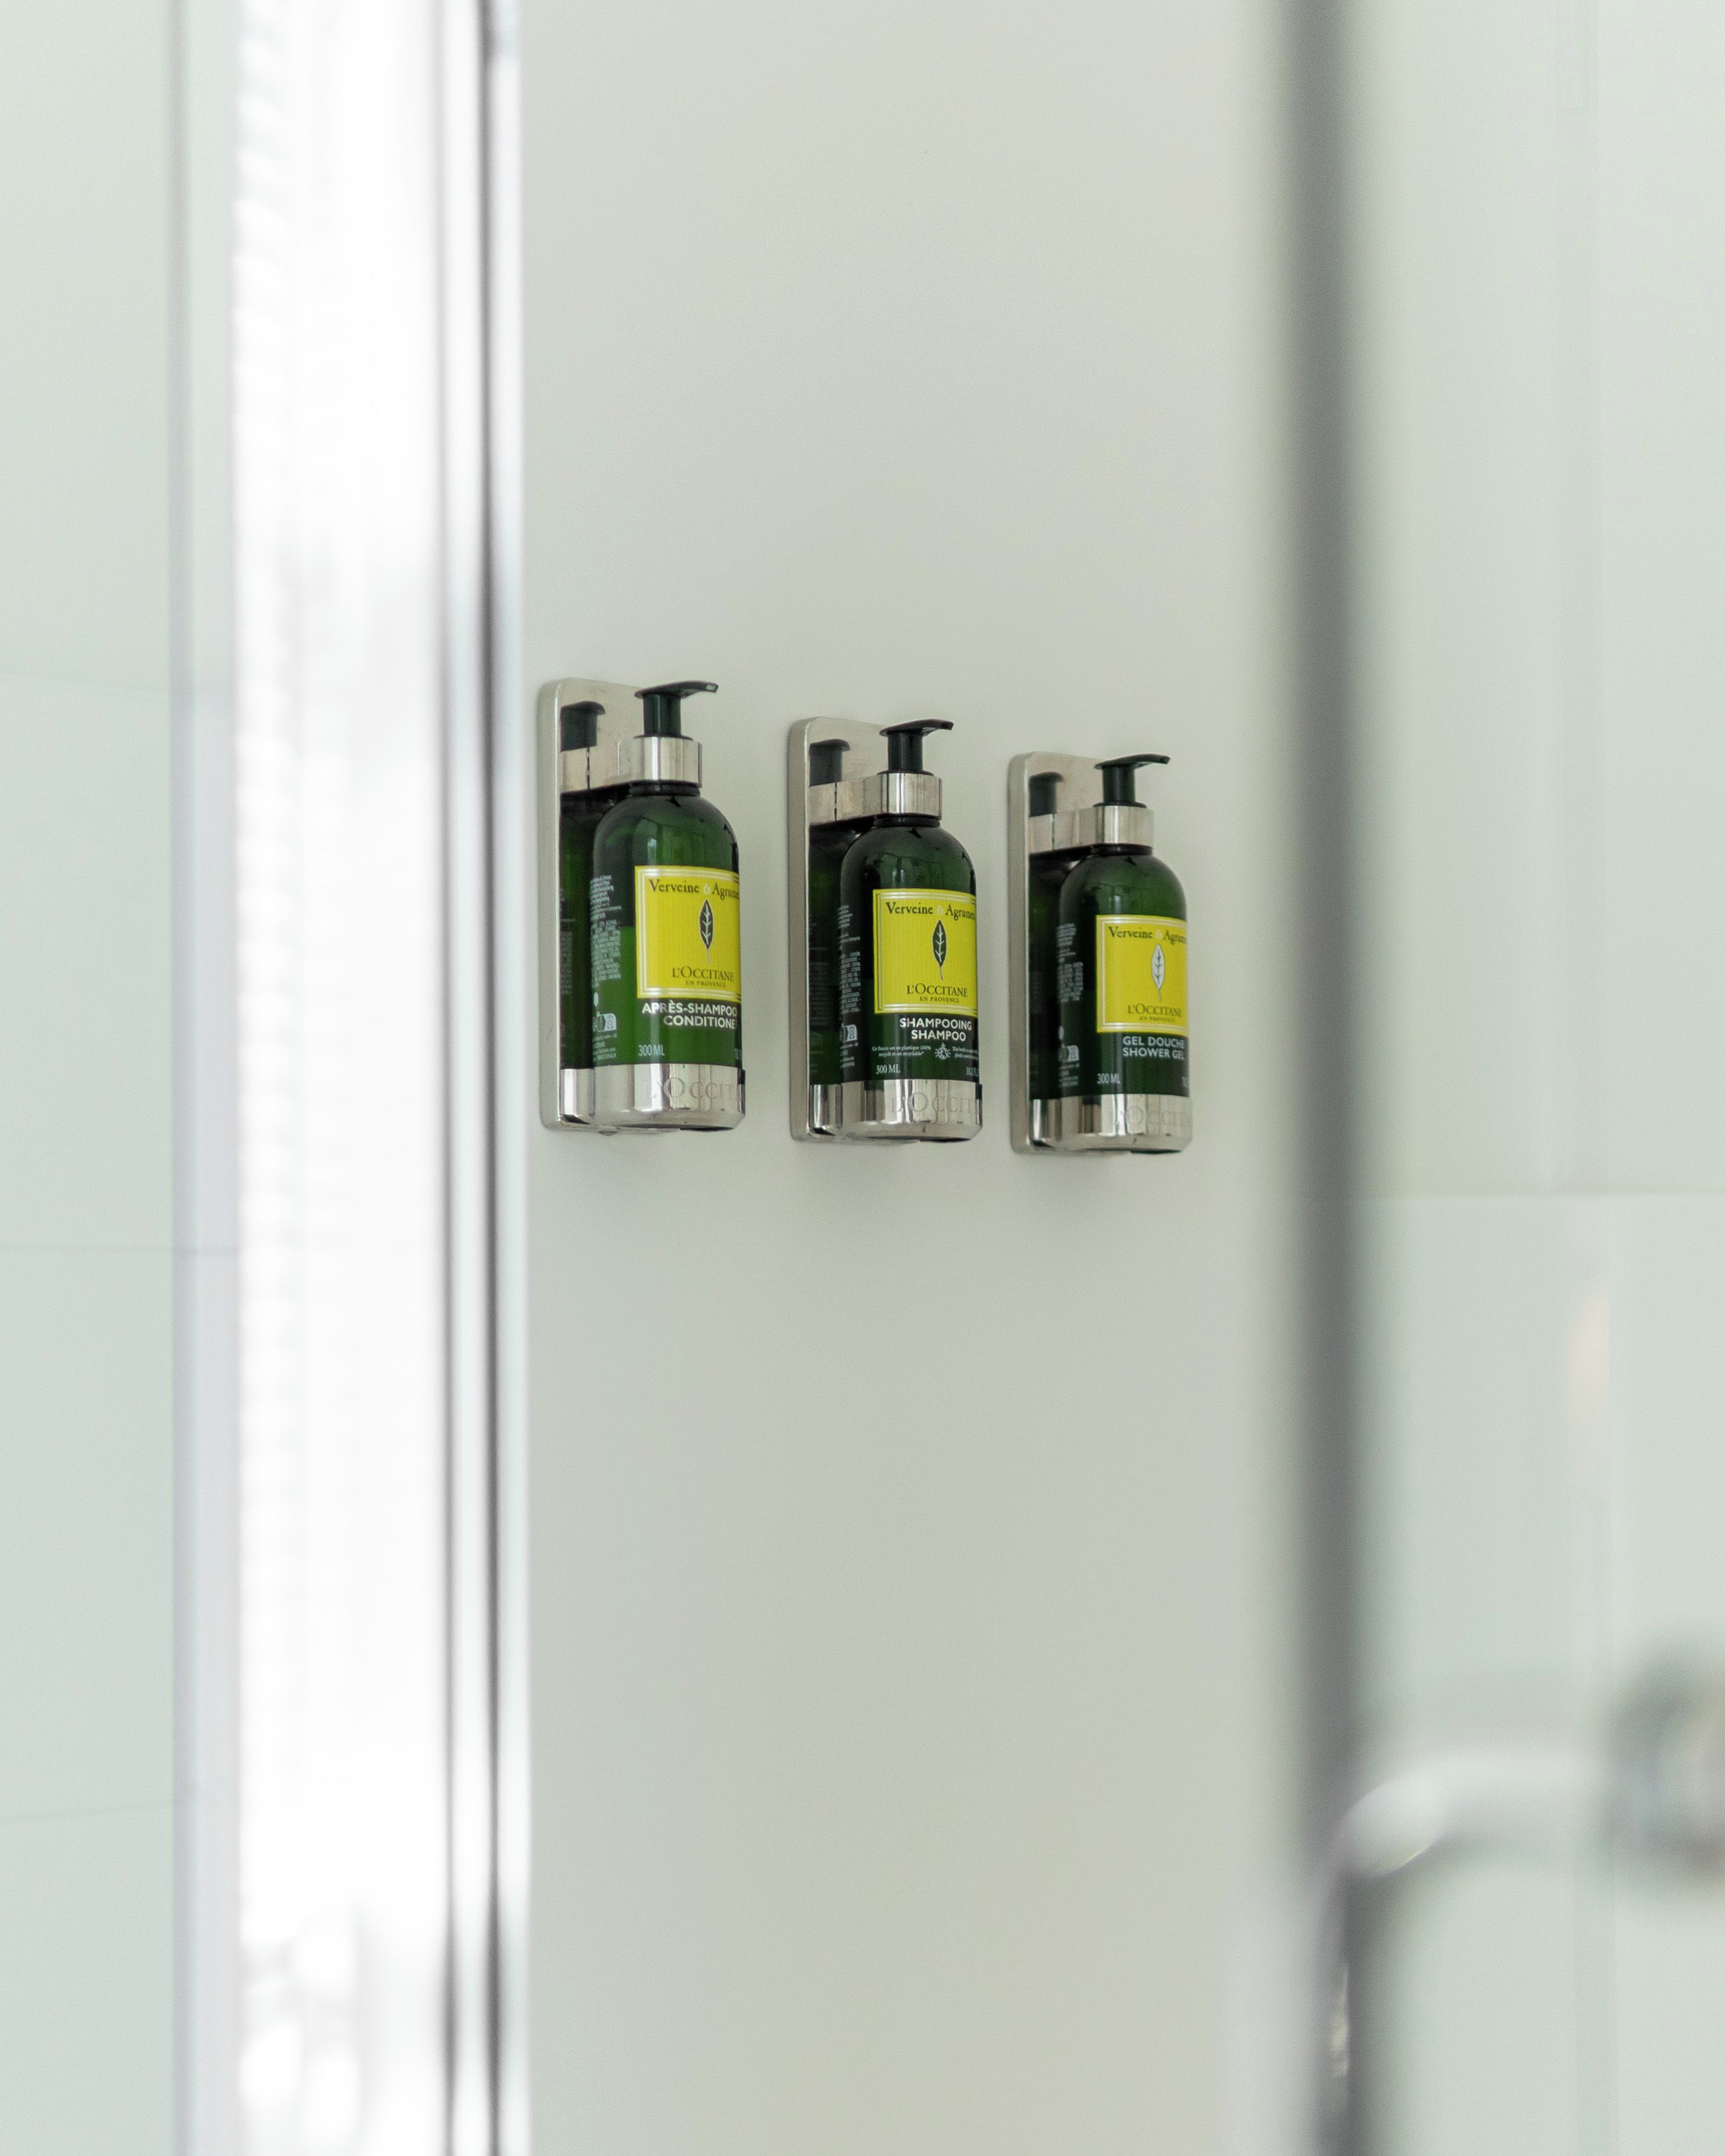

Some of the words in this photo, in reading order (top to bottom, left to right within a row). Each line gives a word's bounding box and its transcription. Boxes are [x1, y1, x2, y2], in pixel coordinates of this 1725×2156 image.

[648, 879, 699, 893] Verveine
[712, 882, 740, 900] Agrume
[886, 902, 933, 914] Verveine
[1108, 926, 1153, 939] Verveine
[900, 1018, 972, 1031] SHAMPOOING
[911, 1030, 967, 1042] SHAMPOO
[1123, 1036, 1145, 1046] GEL
[1148, 1036, 1185, 1049] DOUCHE
[638, 1044, 652, 1056] 300
[653, 1044, 665, 1055] ML
[1123, 1047, 1171, 1058] SHOWER
[1172, 1049, 1185, 1060] GEL
[876, 1064, 888, 1075] 300
[888, 1063, 900, 1074] ML
[1097, 1073, 1110, 1085] 300
[1110, 1073, 1121, 1084] ML
